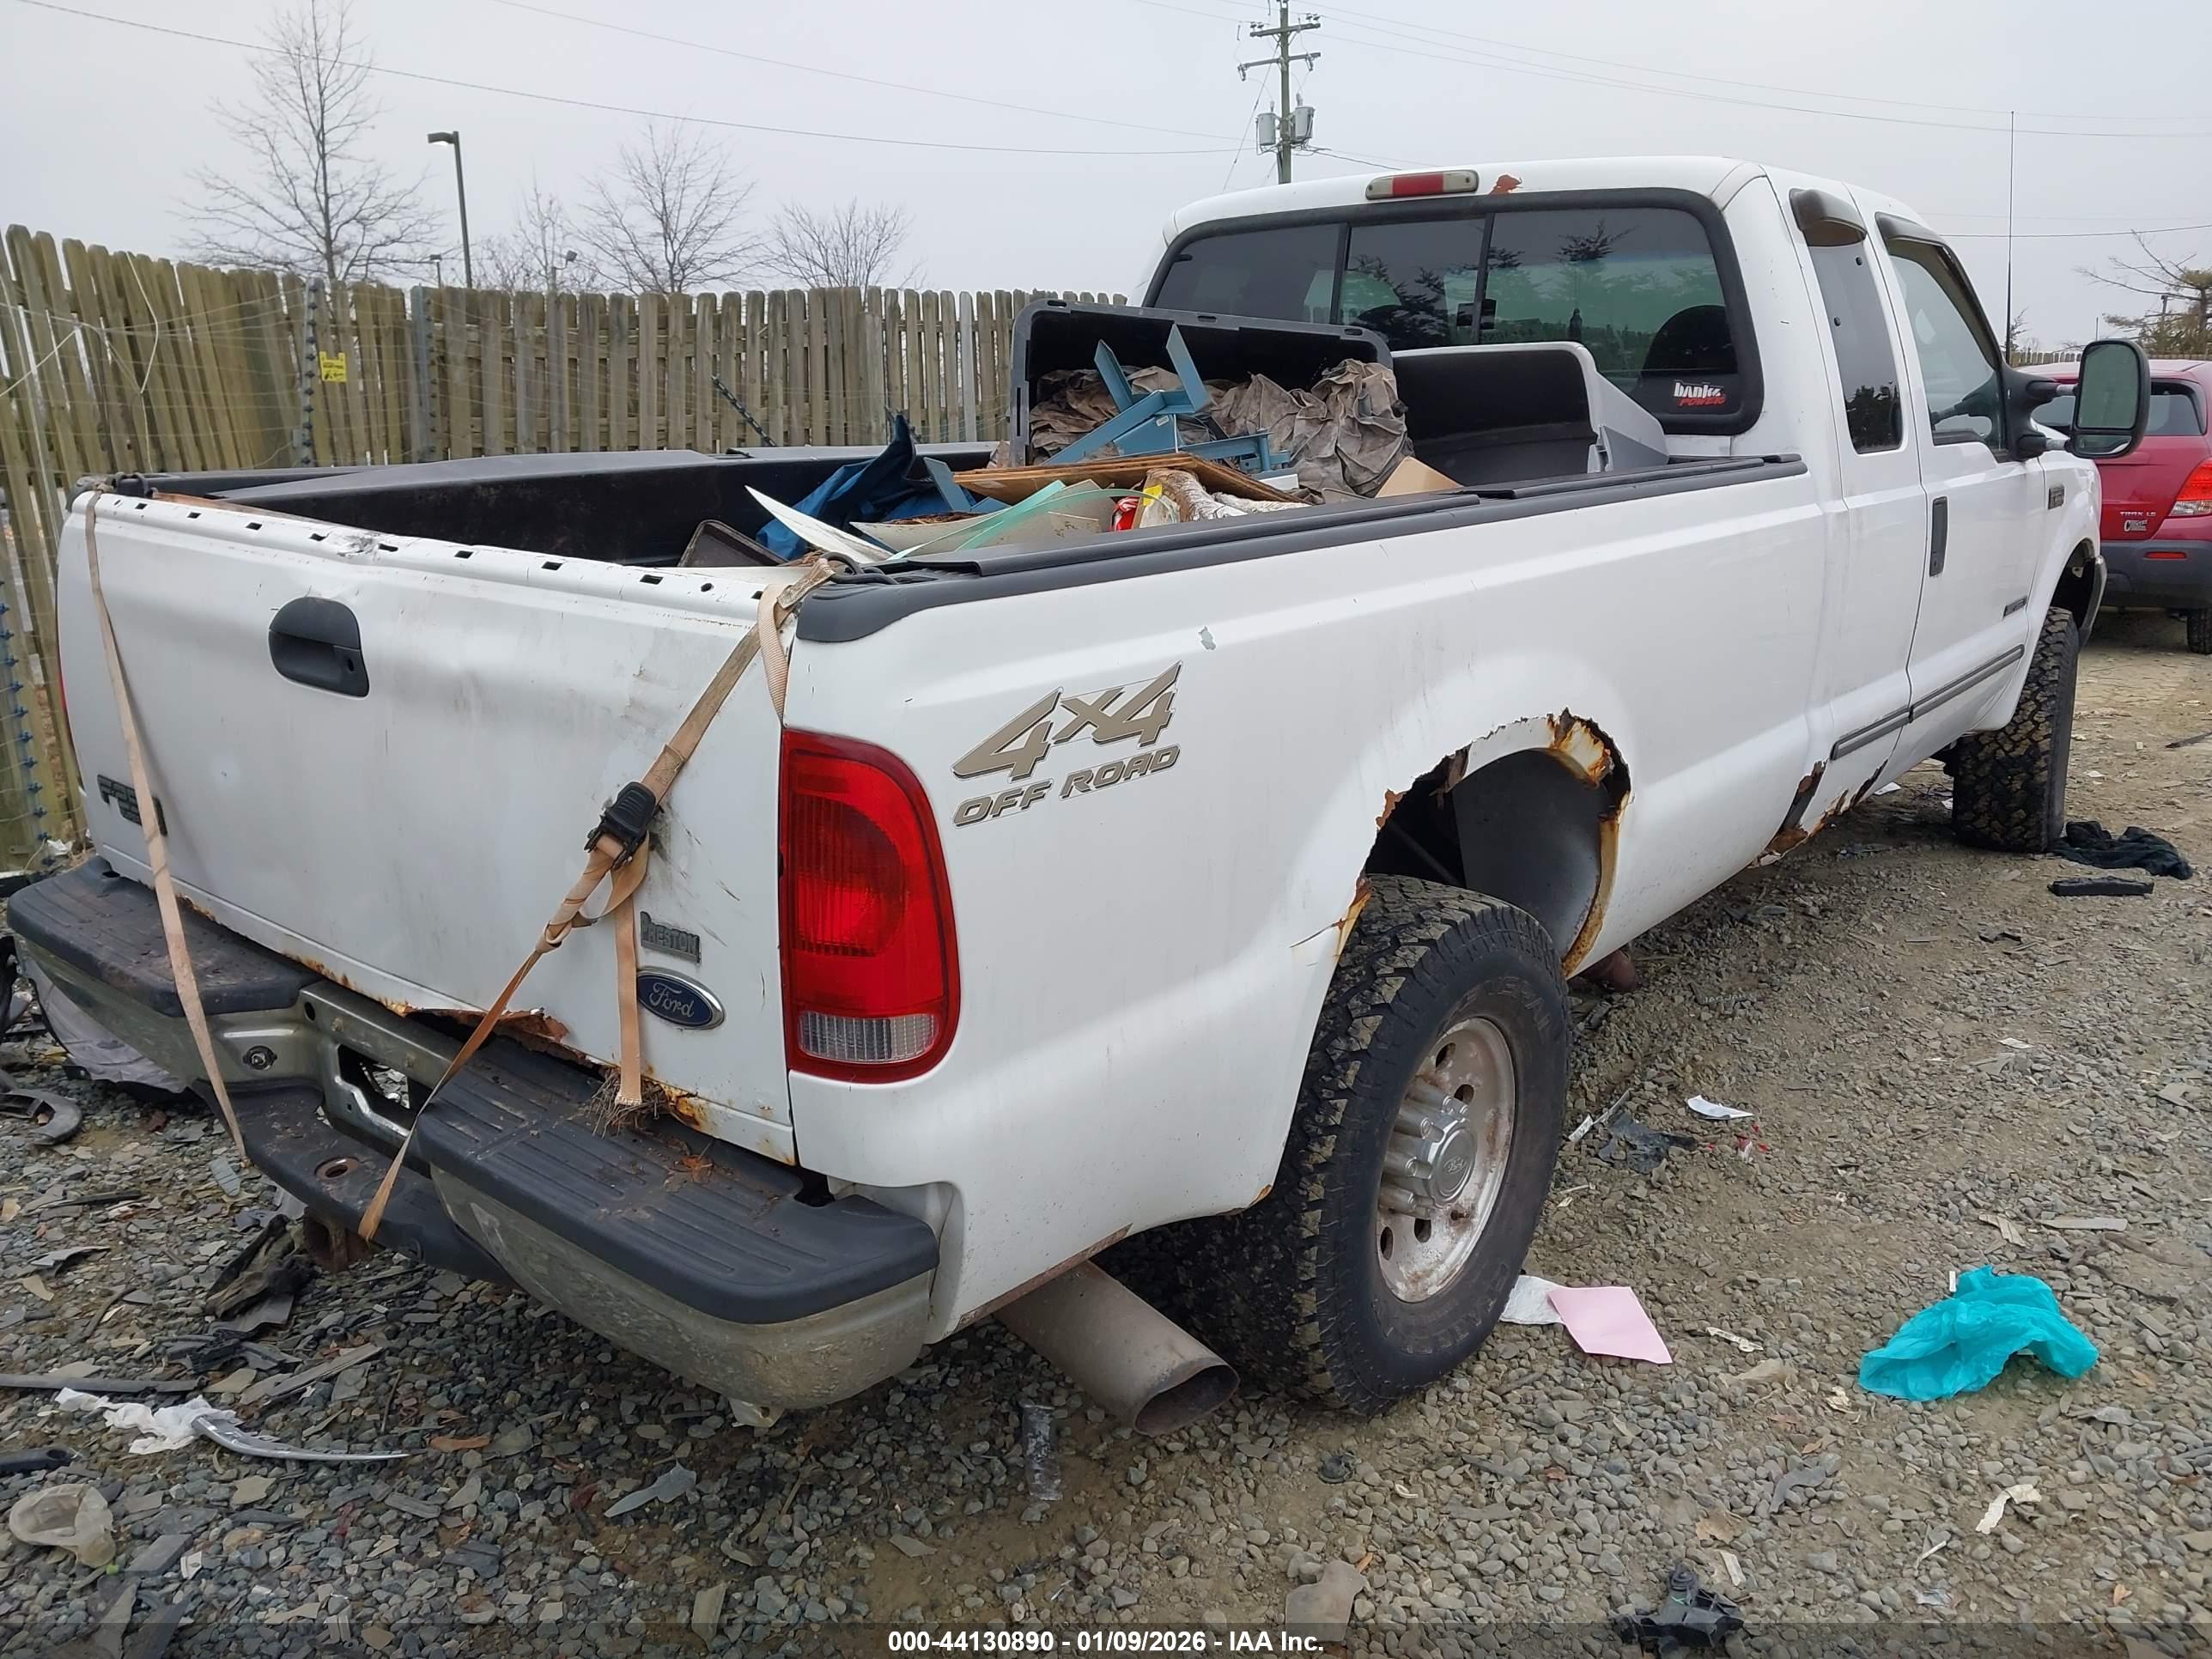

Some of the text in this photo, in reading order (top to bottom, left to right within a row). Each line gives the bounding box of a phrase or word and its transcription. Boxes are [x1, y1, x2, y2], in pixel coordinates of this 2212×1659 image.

[952, 744, 1182, 828] OFF ROAD
[640, 911, 700, 958] PRESTON
[648, 981, 695, 1018] Ford
